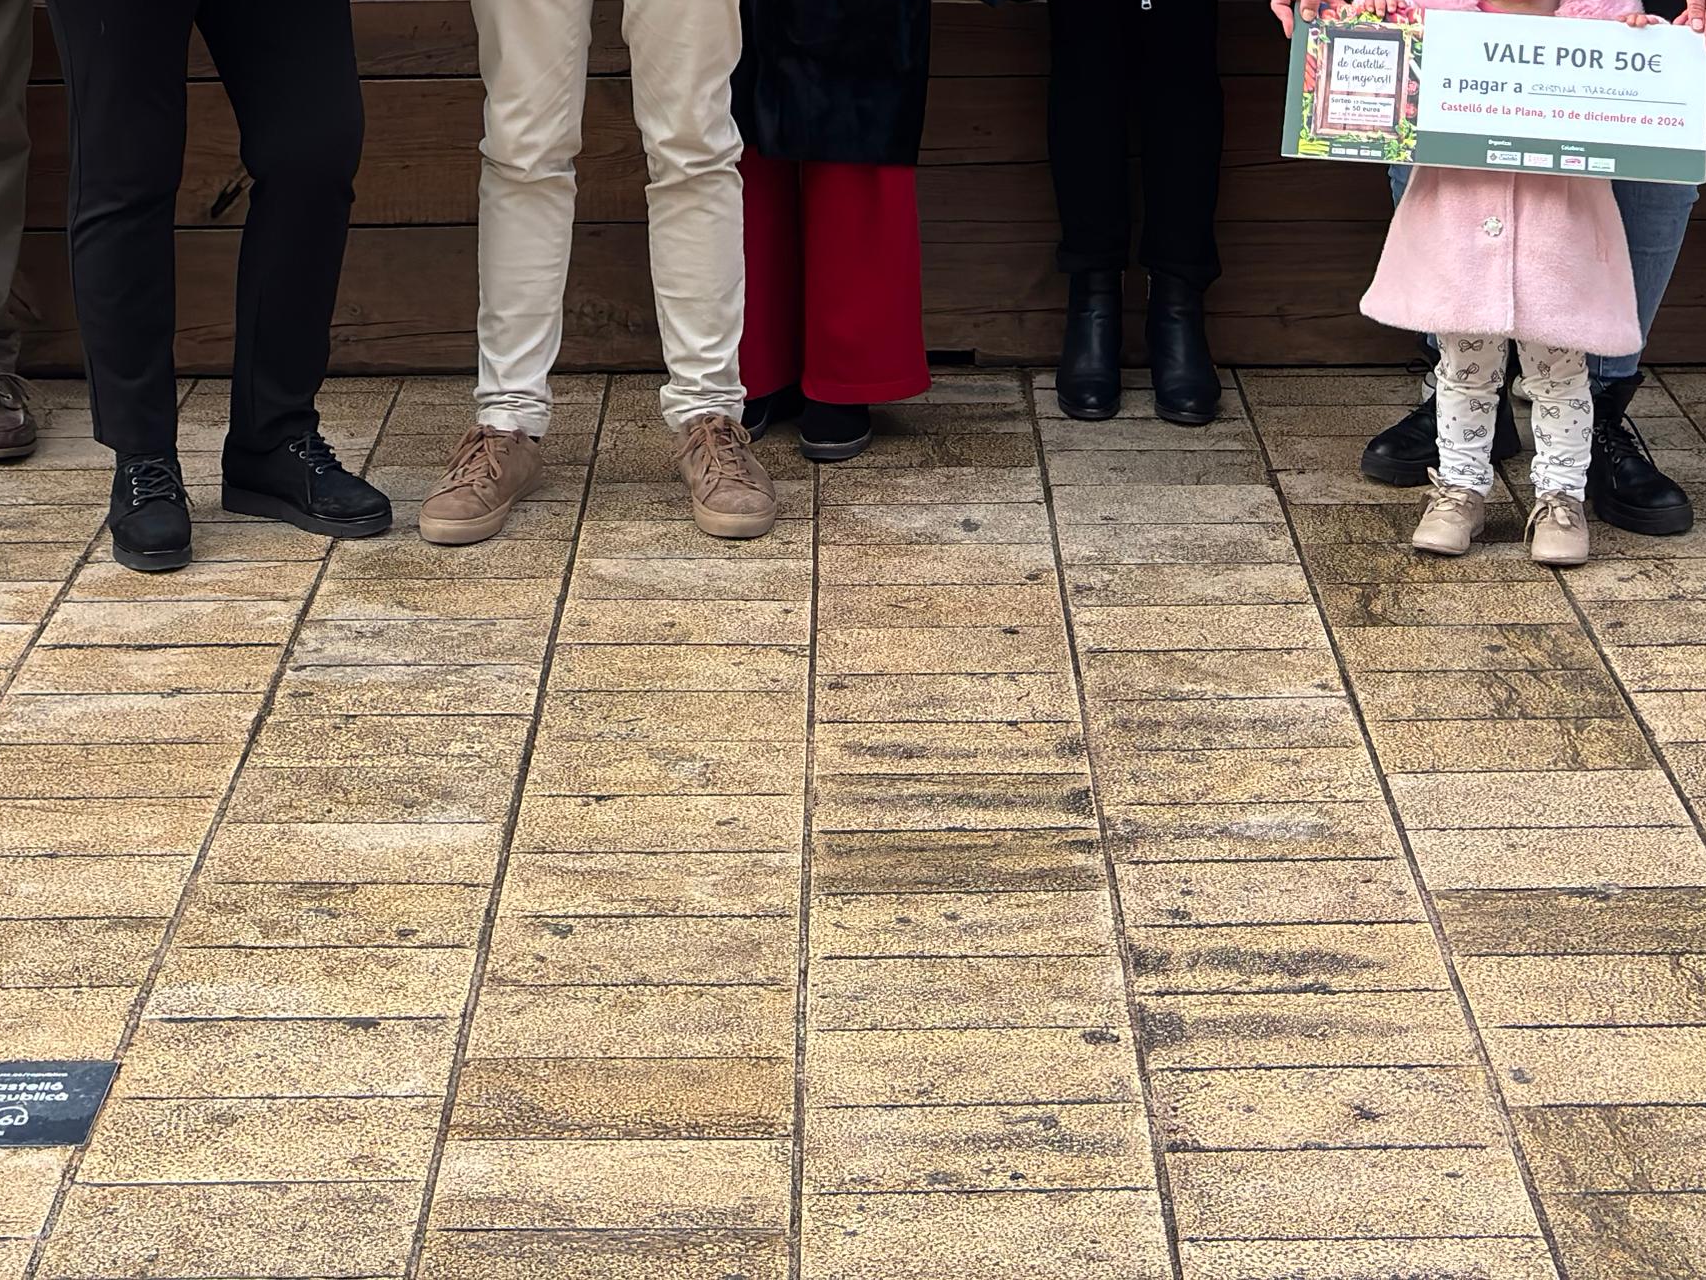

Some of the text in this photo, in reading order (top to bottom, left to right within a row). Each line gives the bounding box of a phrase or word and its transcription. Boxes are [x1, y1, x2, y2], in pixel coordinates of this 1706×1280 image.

[1483, 42, 1661, 72] VALE POR 50€
[1442, 77, 1522, 95] a pagar a
[1440, 101, 1684, 127] Castelló de la Plana, 10 de diciembre de 2024
